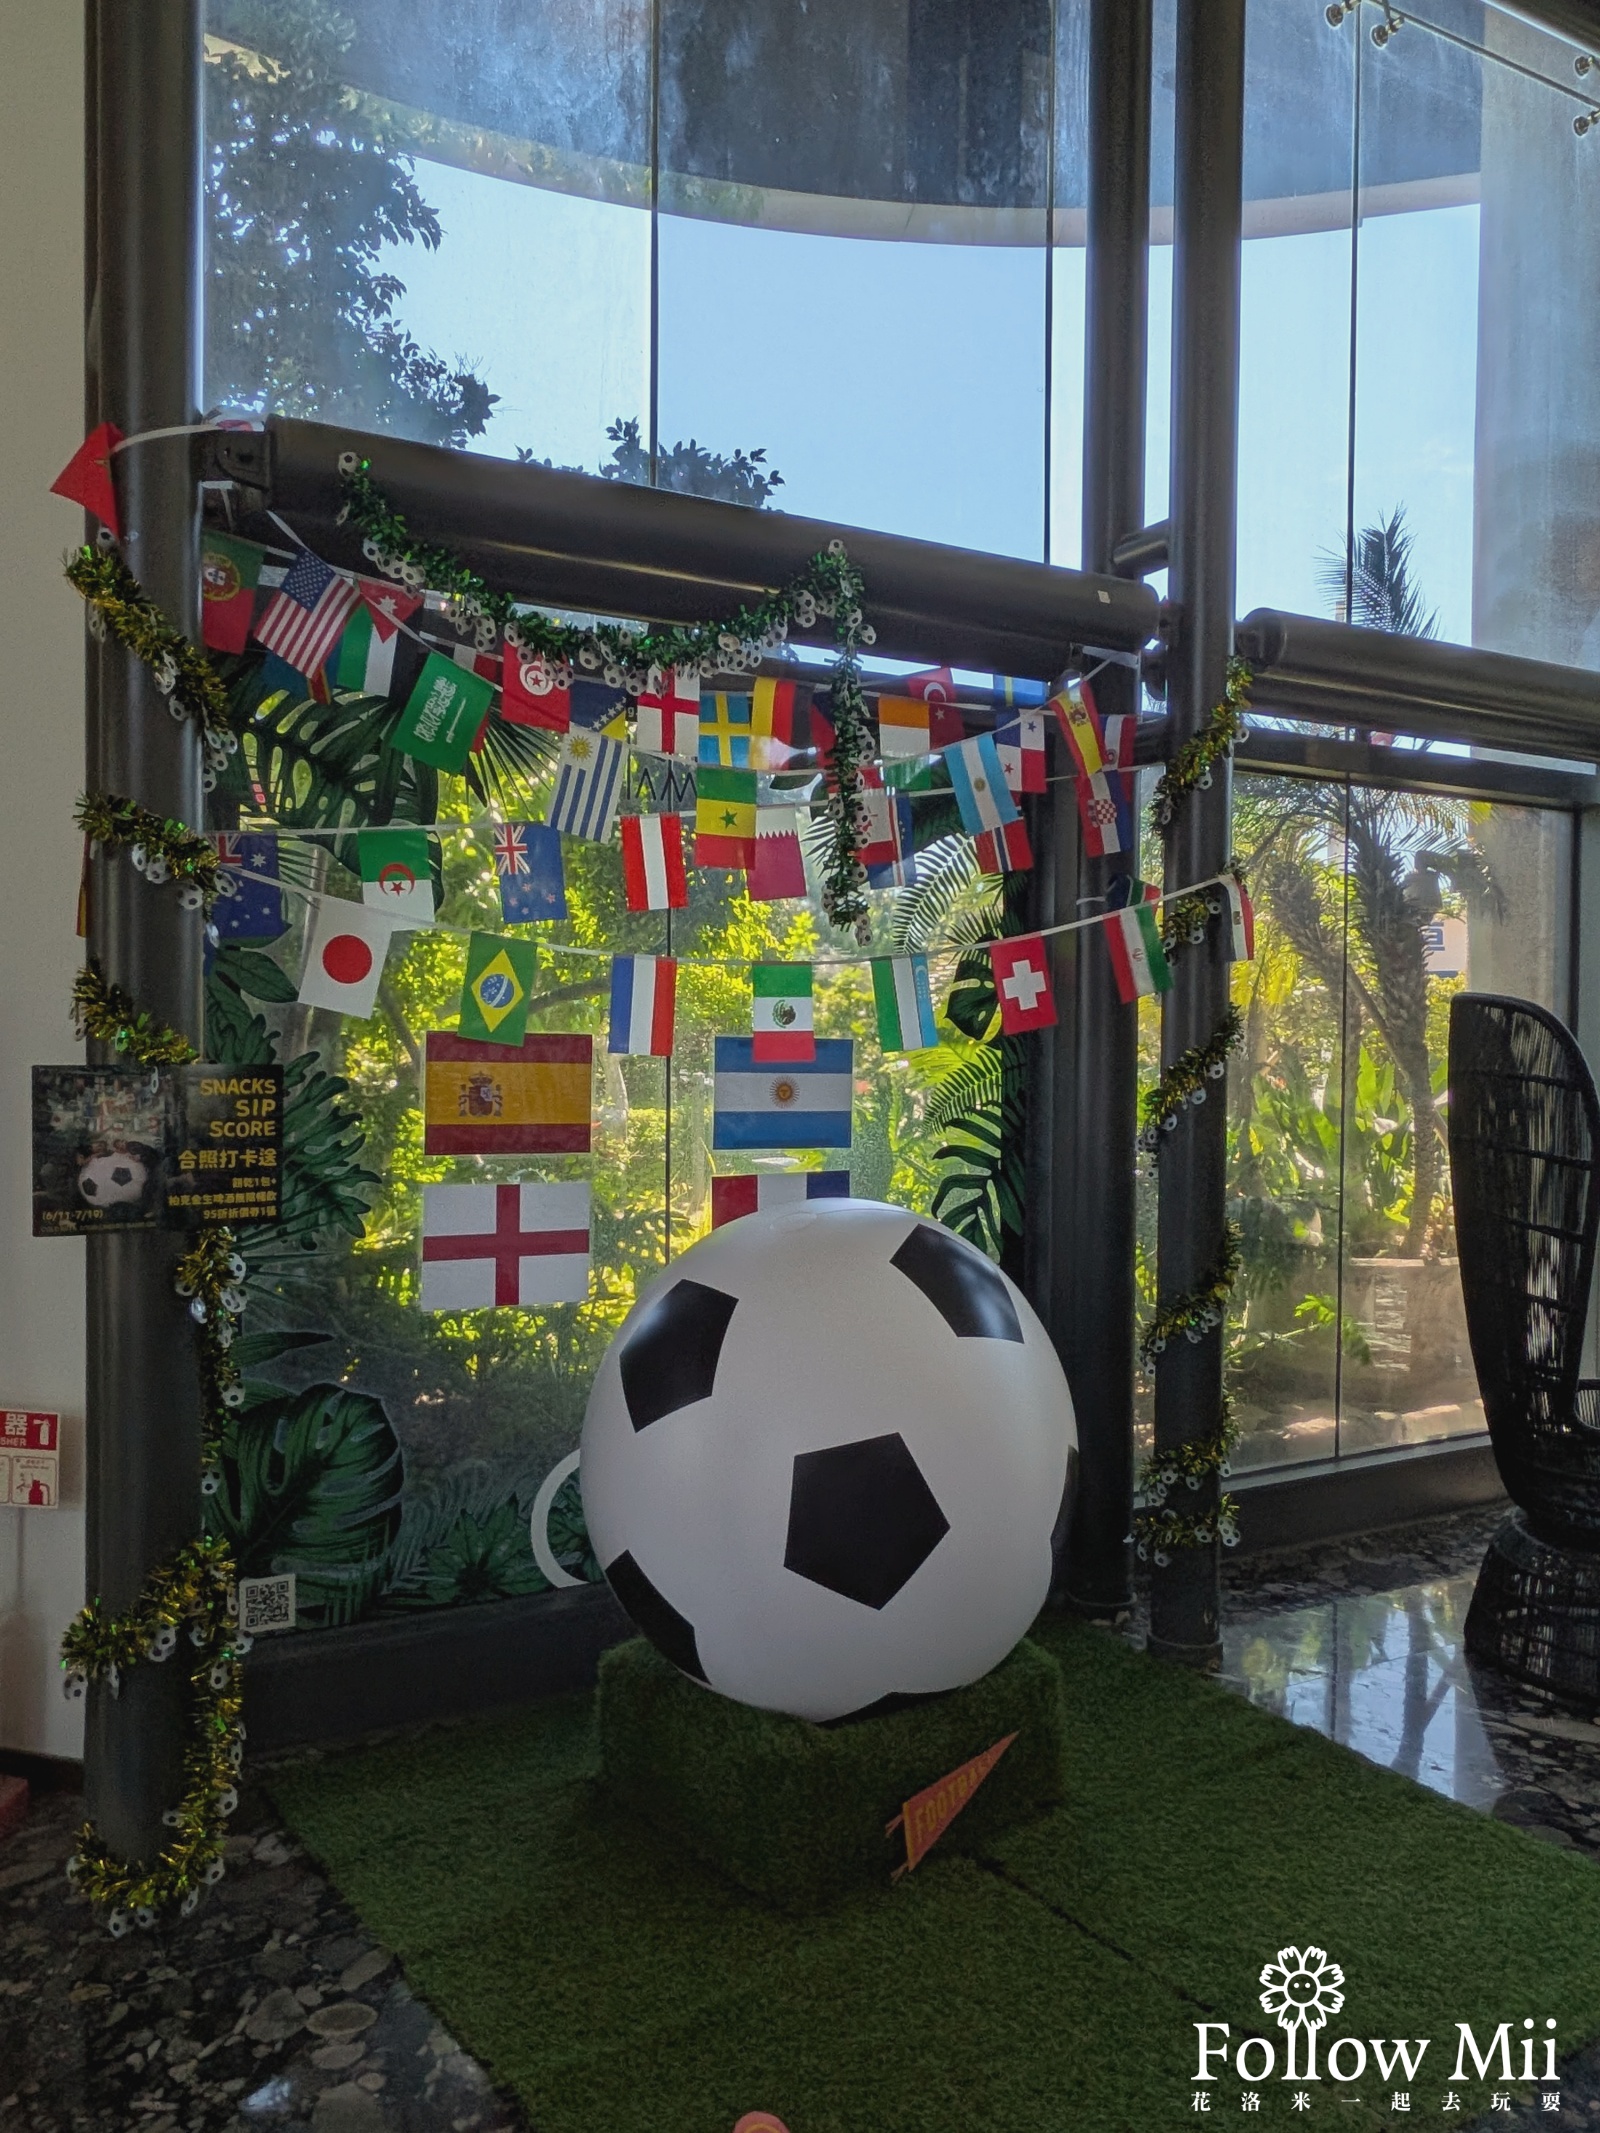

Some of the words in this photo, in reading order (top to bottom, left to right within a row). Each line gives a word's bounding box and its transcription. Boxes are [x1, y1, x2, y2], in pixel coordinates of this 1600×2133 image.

[200, 1077, 277, 1096] SNACKS
[235, 1098, 277, 1118] SIP
[208, 1120, 277, 1138] SCORE
[178, 1147, 278, 1170] 合照打卡送
